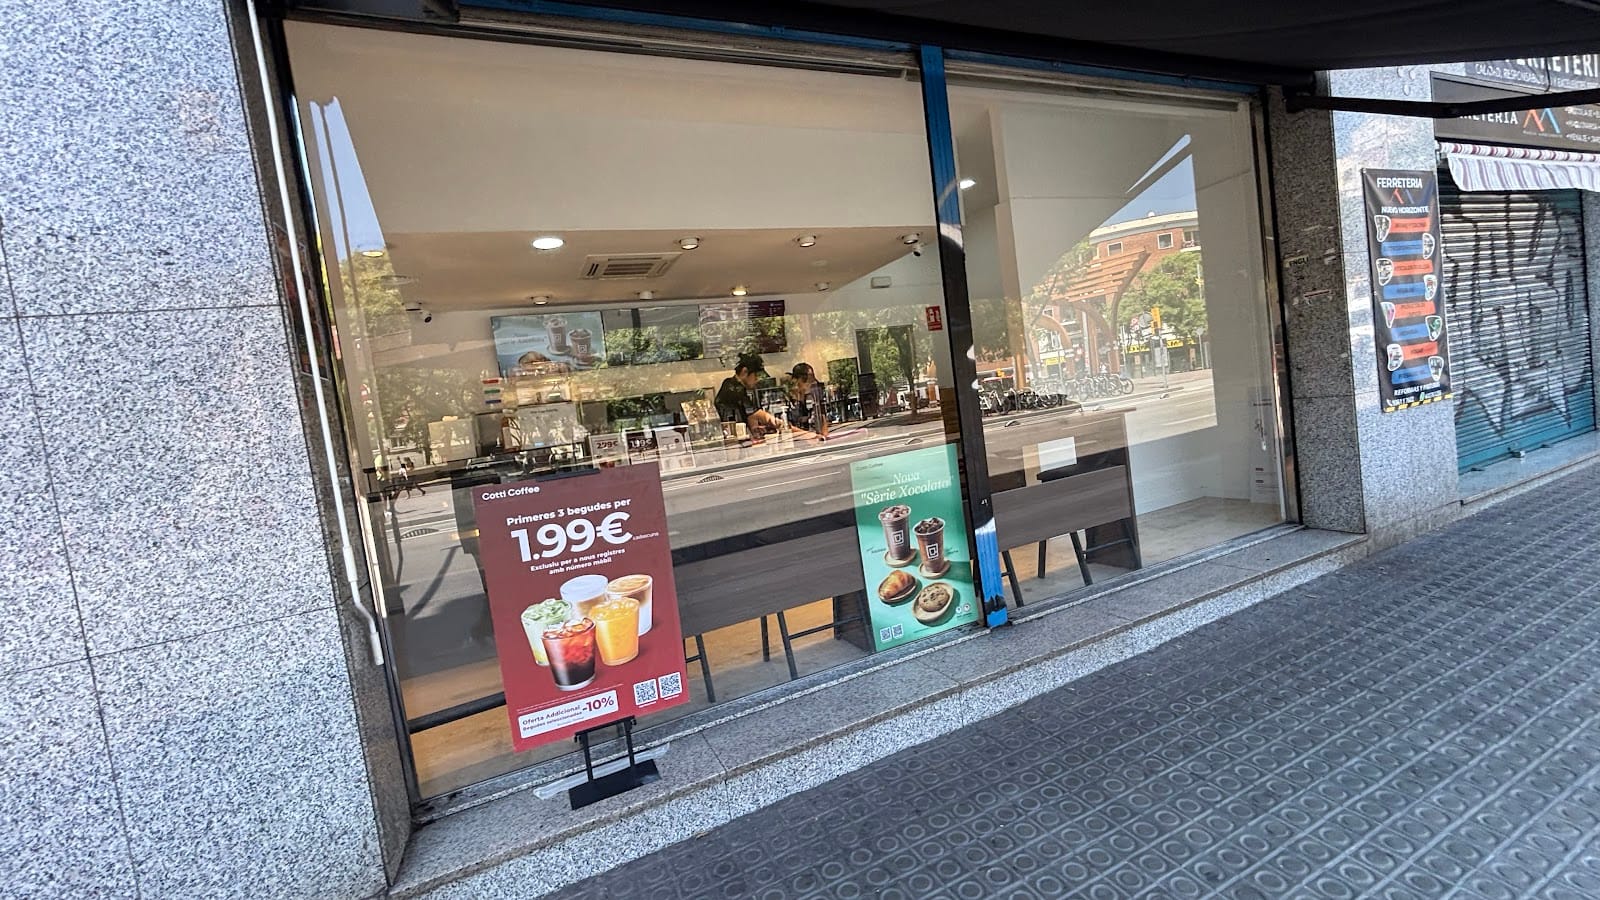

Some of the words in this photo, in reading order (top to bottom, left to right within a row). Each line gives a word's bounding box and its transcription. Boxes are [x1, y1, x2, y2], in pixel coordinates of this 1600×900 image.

[1376, 178, 1423, 189] FERRETERIA
[893, 472, 921, 485] Nova
[481, 490, 507, 501] Cotti
[507, 486, 540, 497] Coffee
[506, 510, 556, 526] Primeres
[557, 509, 565, 518] 3
[566, 502, 612, 517] begudes
[614, 498, 632, 510] per
[510, 511, 633, 562] 1.99€
[530, 561, 559, 572] Exclusiu
[560, 559, 572, 567] per
[579, 554, 596, 562] nous
[597, 548, 626, 559] registres
[549, 567, 565, 575] amb
[522, 716, 544, 725] Oferta
[546, 705, 581, 719] Addicional
[582, 695, 615, 713] -10%
